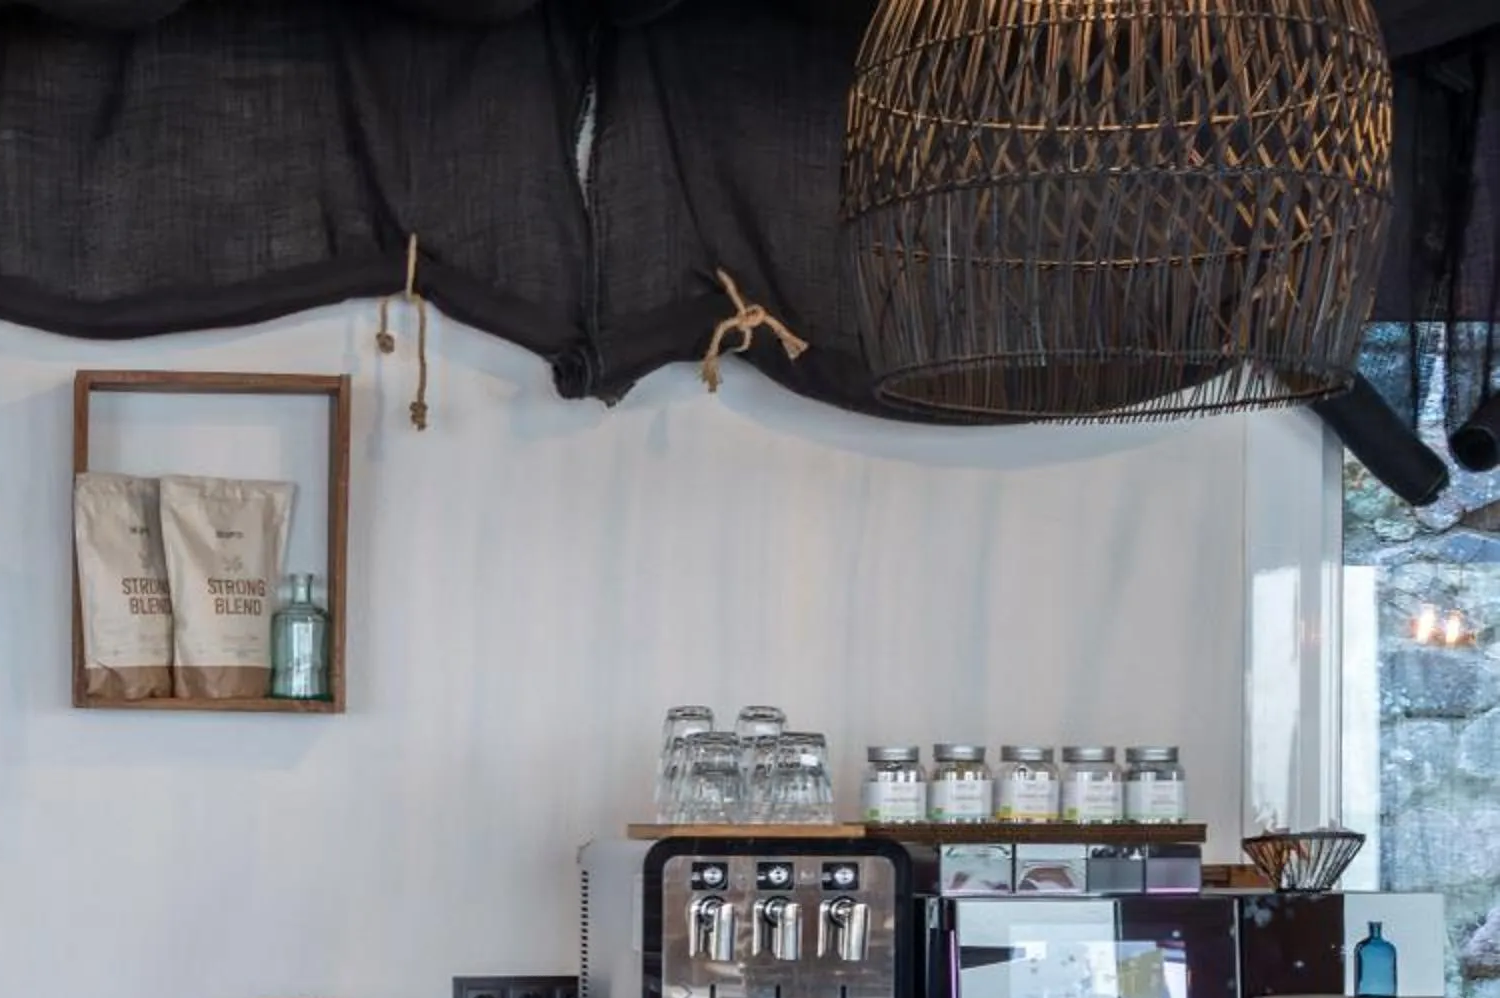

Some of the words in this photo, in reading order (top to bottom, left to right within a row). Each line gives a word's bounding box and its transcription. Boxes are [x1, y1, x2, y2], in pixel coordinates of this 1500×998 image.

[121, 577, 170, 595] STRON
[207, 578, 266, 597] STRONG
[214, 598, 262, 616] BLEND
